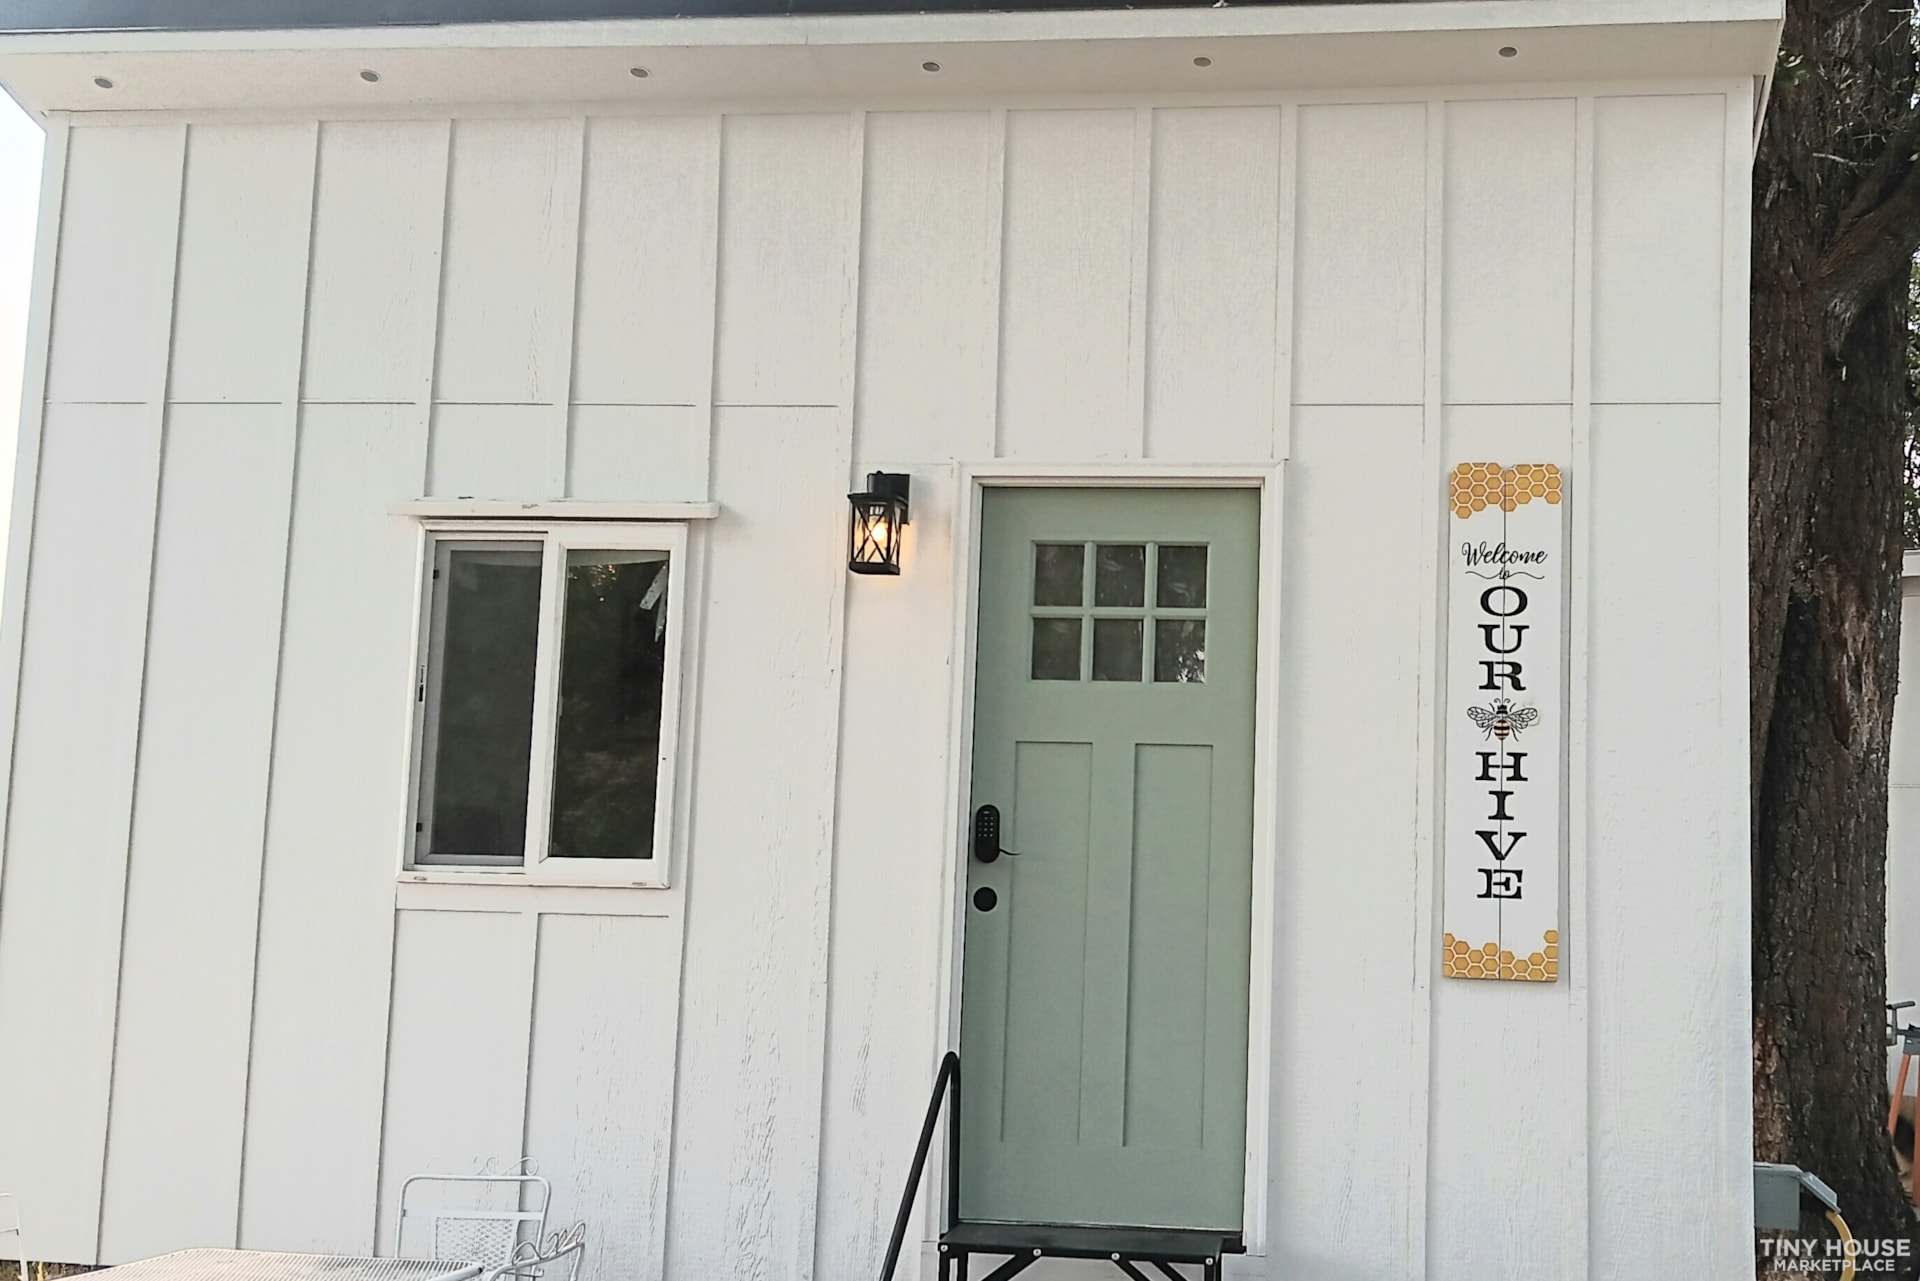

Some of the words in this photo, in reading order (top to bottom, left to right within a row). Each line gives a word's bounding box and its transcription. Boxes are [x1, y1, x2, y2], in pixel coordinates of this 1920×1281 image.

[1461, 541, 1548, 567] Welcome
[1499, 567, 1511, 580] to
[1477, 585, 1530, 691] OUR
[1475, 751, 1528, 899] HIVE
